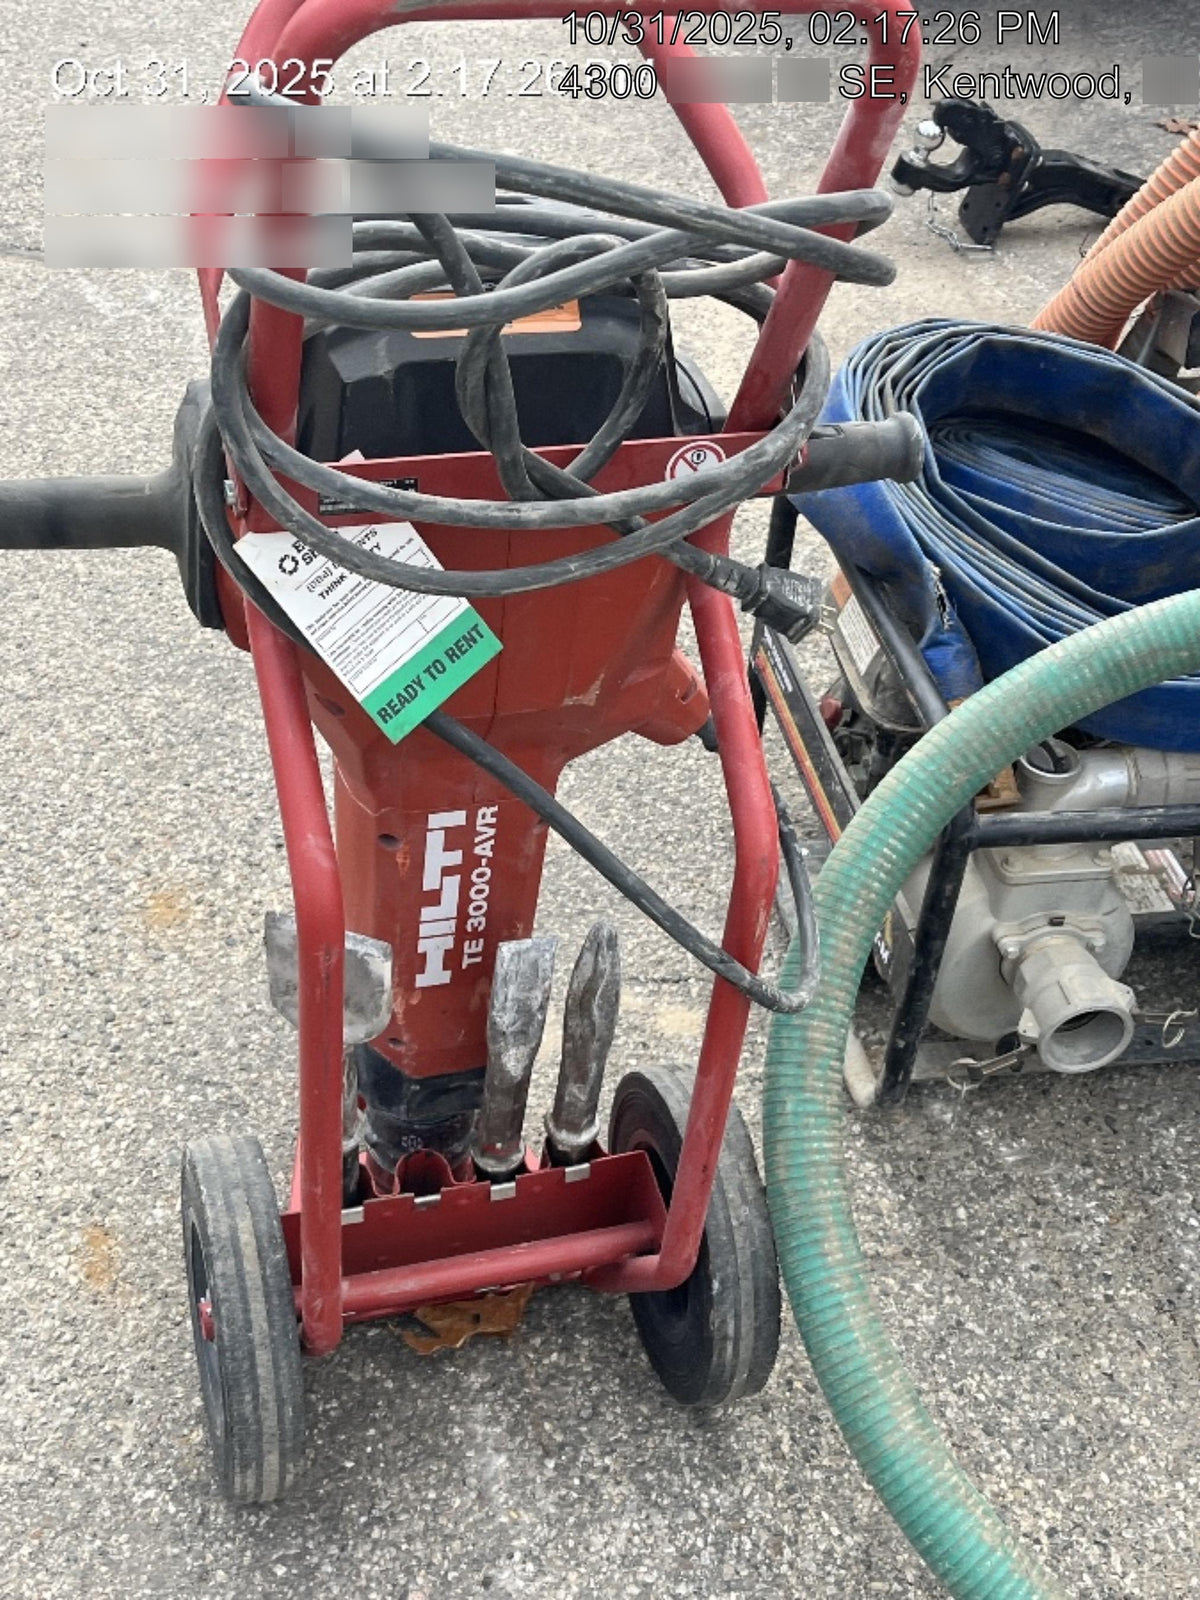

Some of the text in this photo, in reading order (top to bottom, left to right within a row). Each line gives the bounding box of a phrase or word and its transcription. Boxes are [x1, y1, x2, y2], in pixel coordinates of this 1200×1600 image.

[376, 674, 426, 724] READY
[422, 659, 448, 681] TO
[443, 623, 485, 664] RENT
[415, 810, 467, 988] HILTI
[461, 804, 500, 970] TE 3000-AVR
